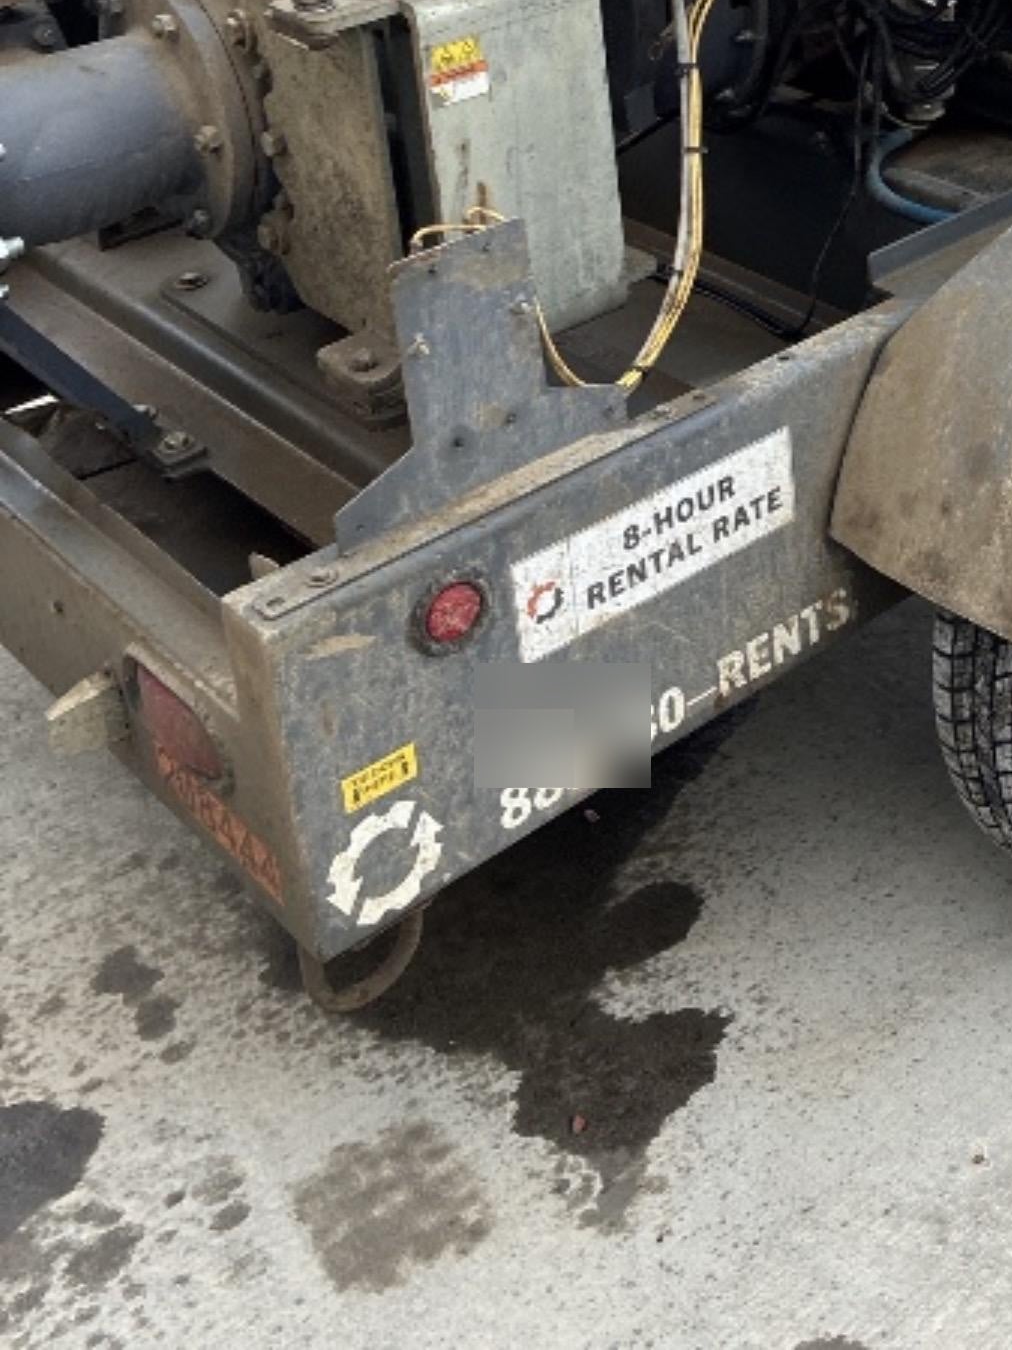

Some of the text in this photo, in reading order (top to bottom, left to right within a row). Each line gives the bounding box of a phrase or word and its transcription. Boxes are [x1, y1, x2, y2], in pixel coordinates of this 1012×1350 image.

[586, 485, 783, 610] RENTAL RATE
[622, 475, 736, 552] 8-HOUR
